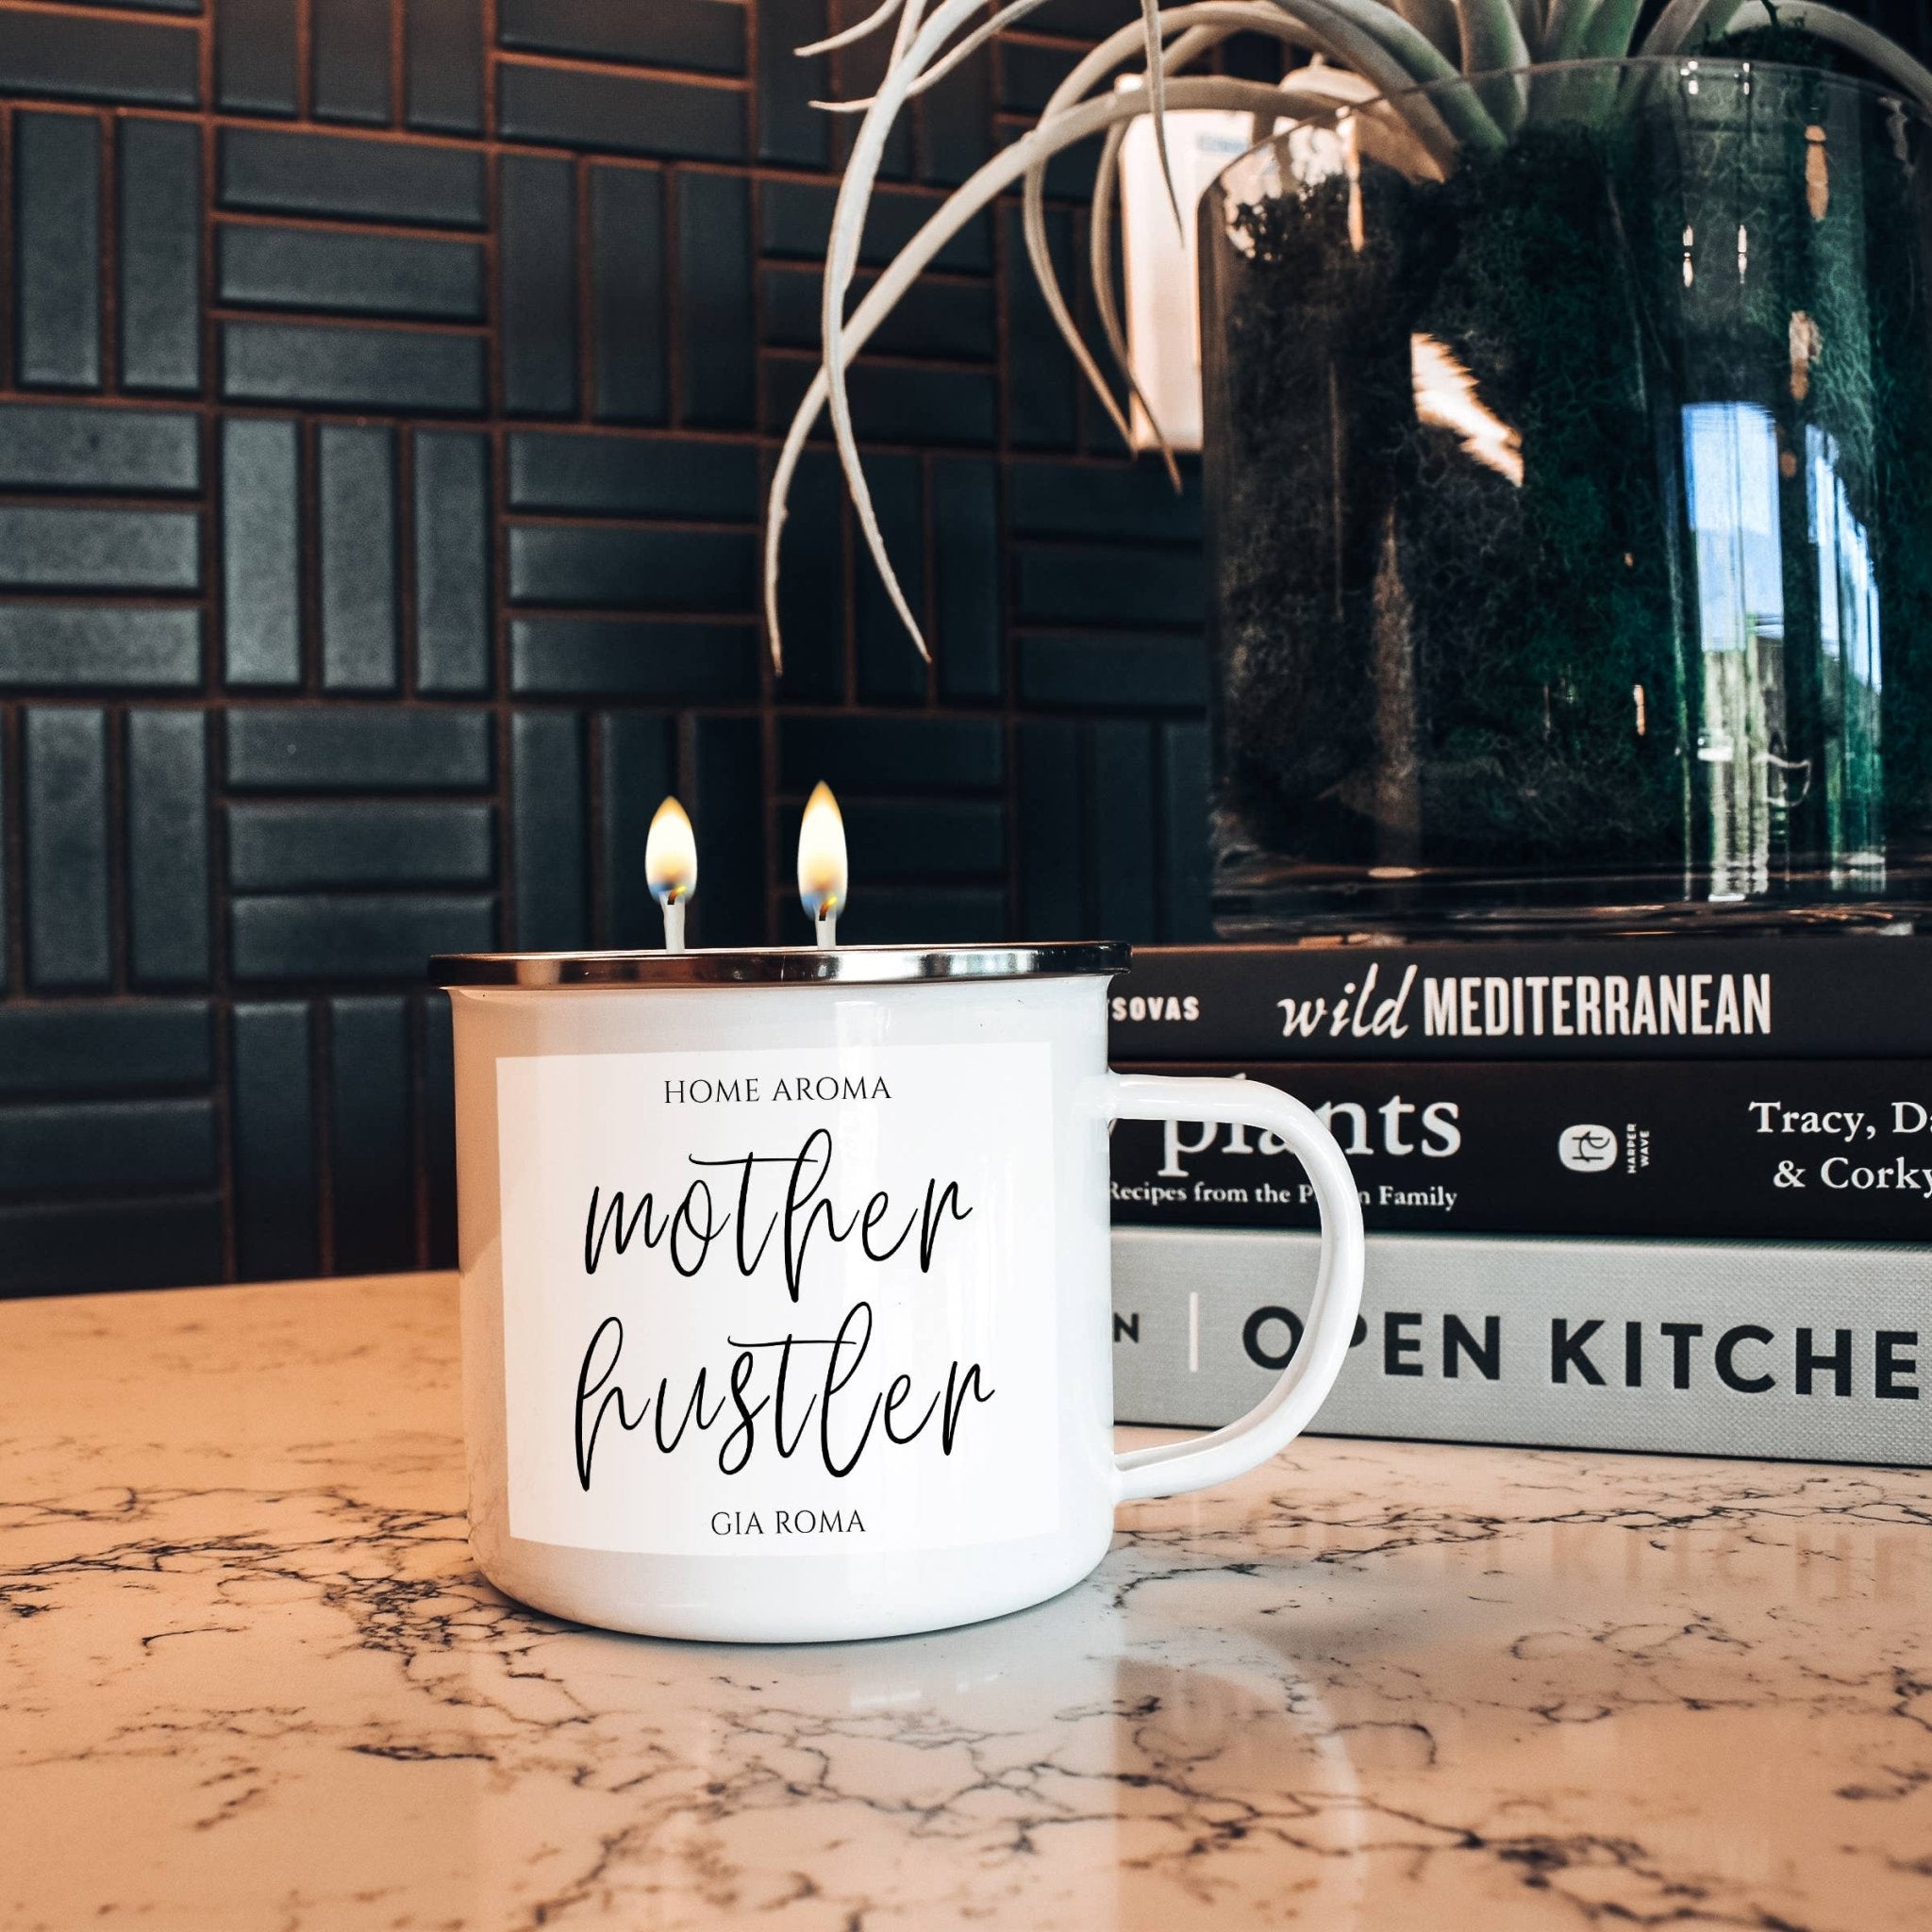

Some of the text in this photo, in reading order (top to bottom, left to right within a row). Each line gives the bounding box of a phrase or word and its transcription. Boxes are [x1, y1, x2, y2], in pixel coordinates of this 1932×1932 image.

[1108, 962, 1771, 1040] SOVAS wild MEDITERRANEAN
[664, 1075, 892, 1104] HOME AROMA
[1748, 1101, 1932, 1142] Tracy, D
[1626, 1123, 1637, 1174] HARPER
[1639, 1131, 1650, 1168] WAVE
[1773, 1159, 1806, 1189] &
[584, 1127, 974, 1304] mother
[1194, 1181, 1248, 1203] from
[1255, 1183, 1291, 1203] the
[1379, 1185, 1456, 1211] Family
[1551, 1318, 1920, 1400] KITCHE
[575, 1301, 996, 1492] hustler
[709, 1508, 867, 1537] GIA ROMA
